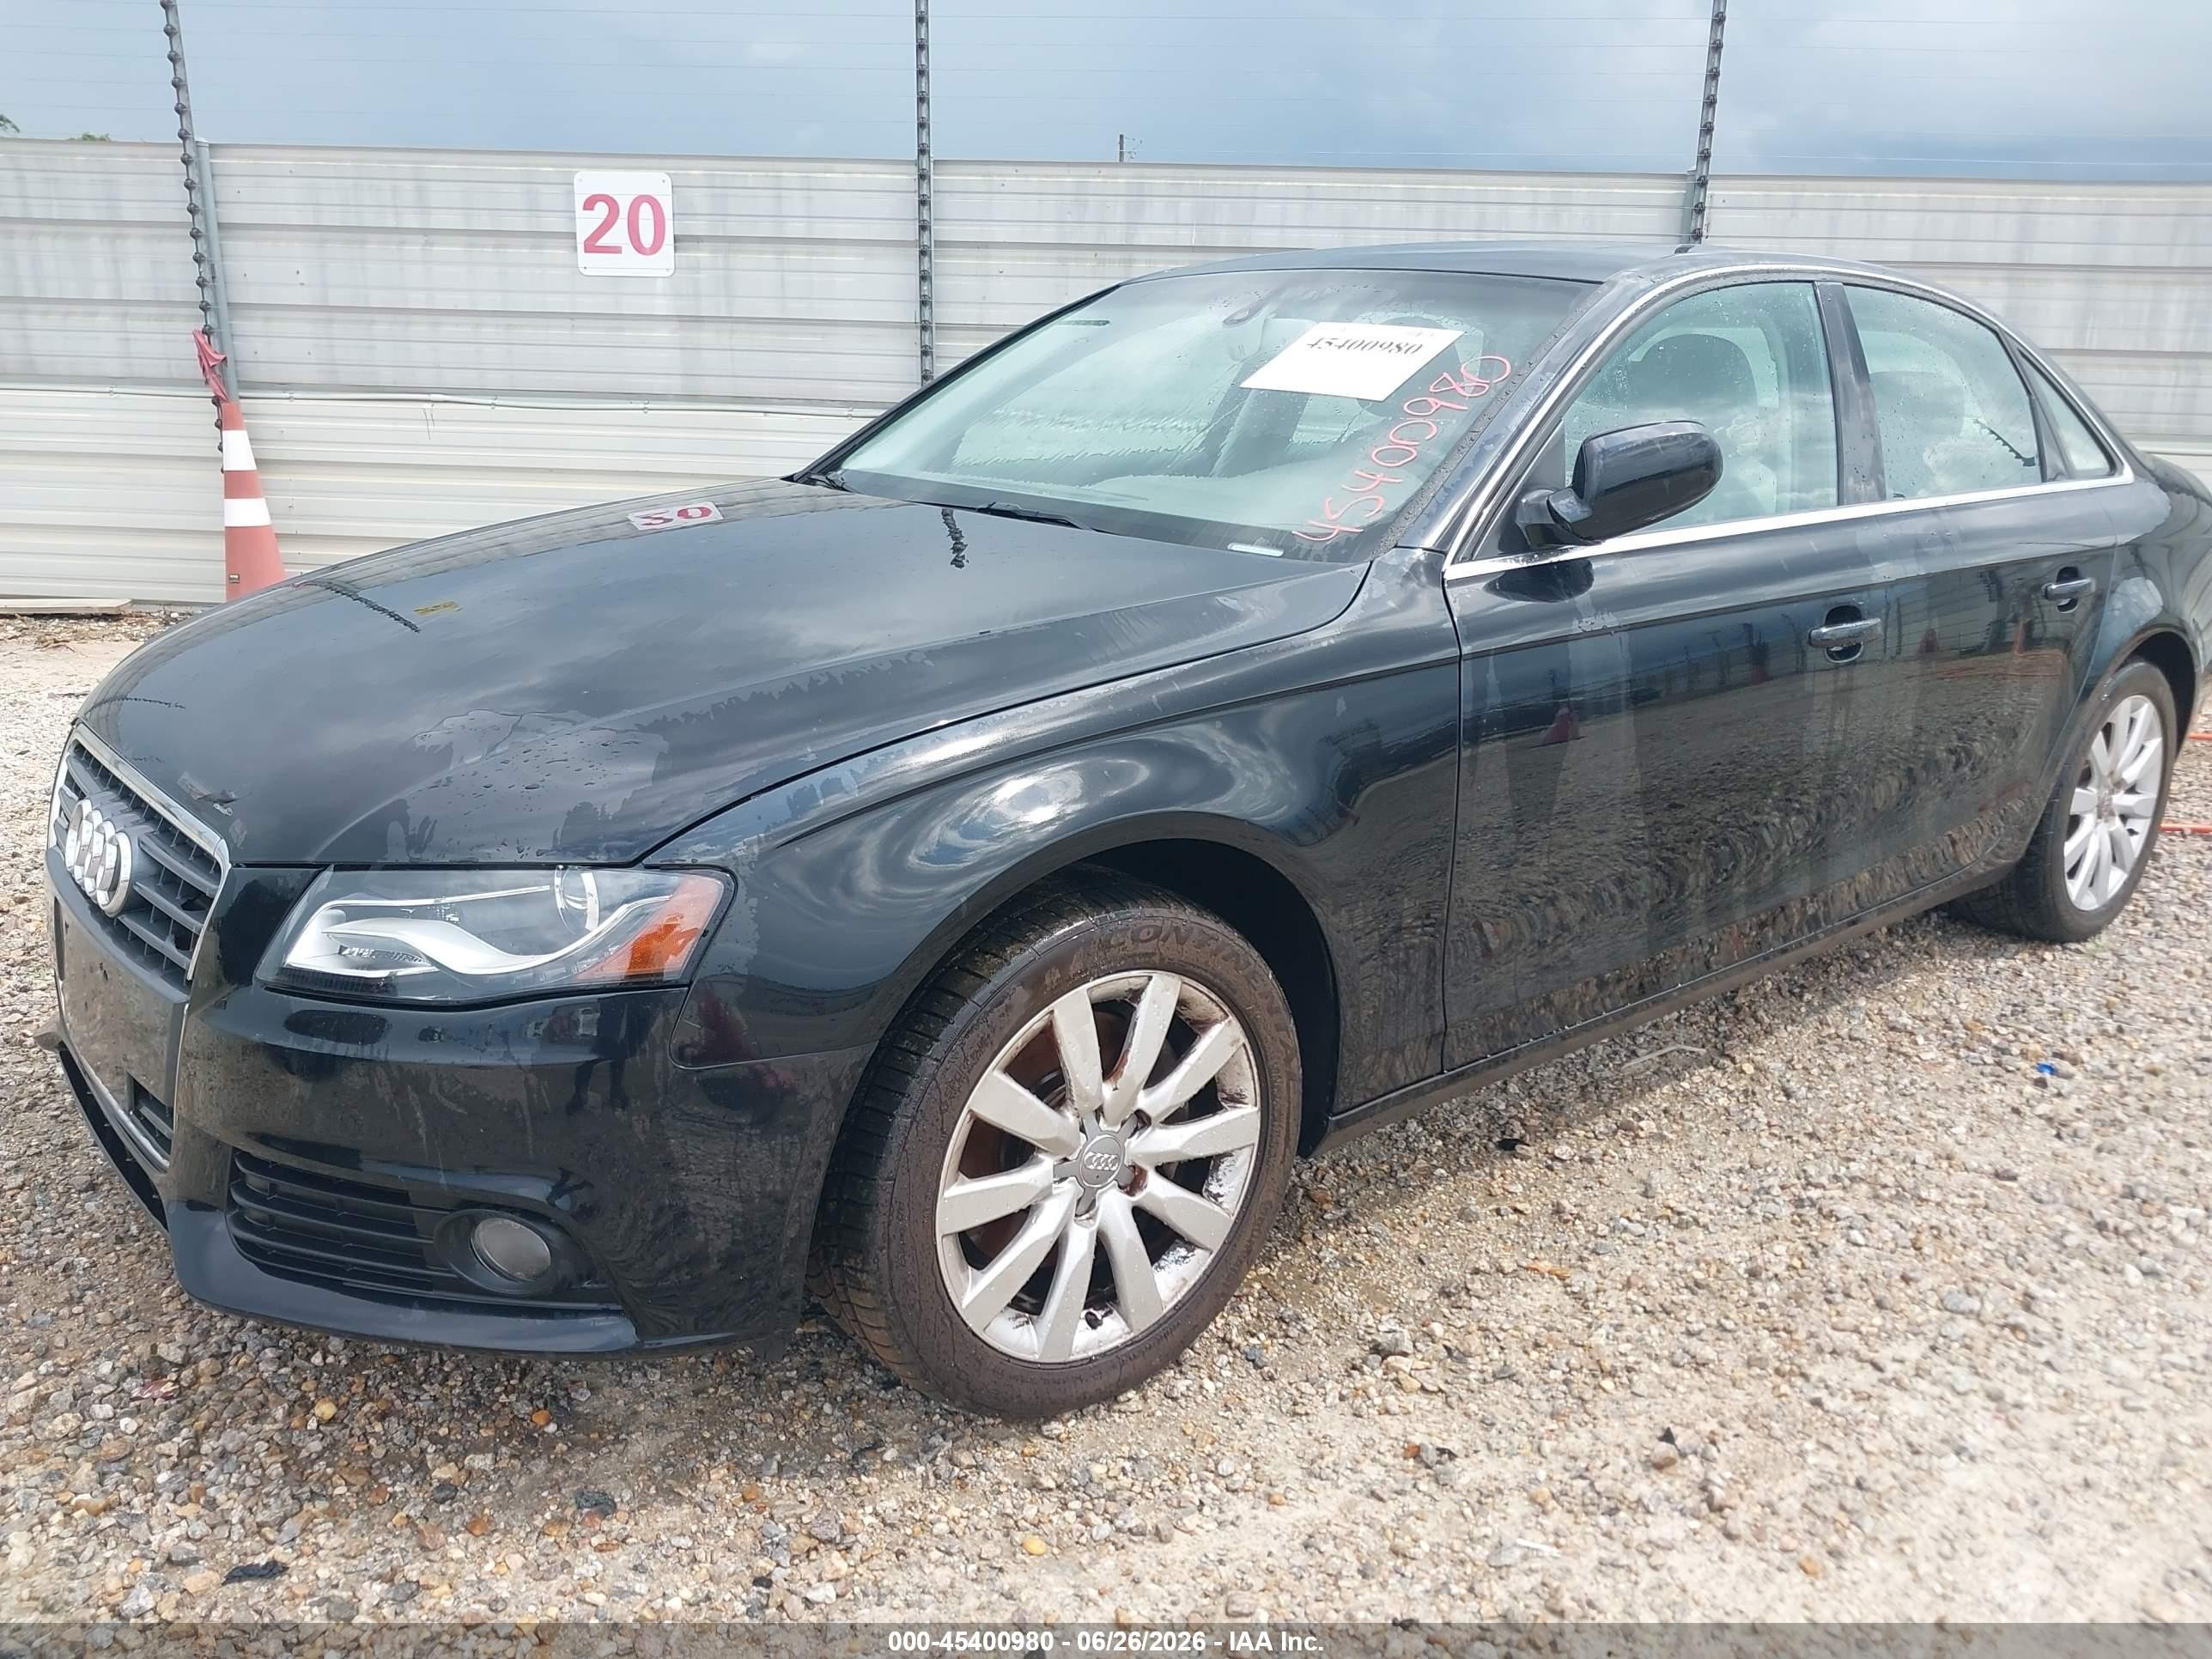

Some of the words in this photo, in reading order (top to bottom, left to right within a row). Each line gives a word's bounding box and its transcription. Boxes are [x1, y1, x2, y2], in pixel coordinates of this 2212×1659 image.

[582, 193, 666, 256] 20
[1307, 337, 1424, 355] 45400980
[1291, 355, 1511, 541] 45400980
